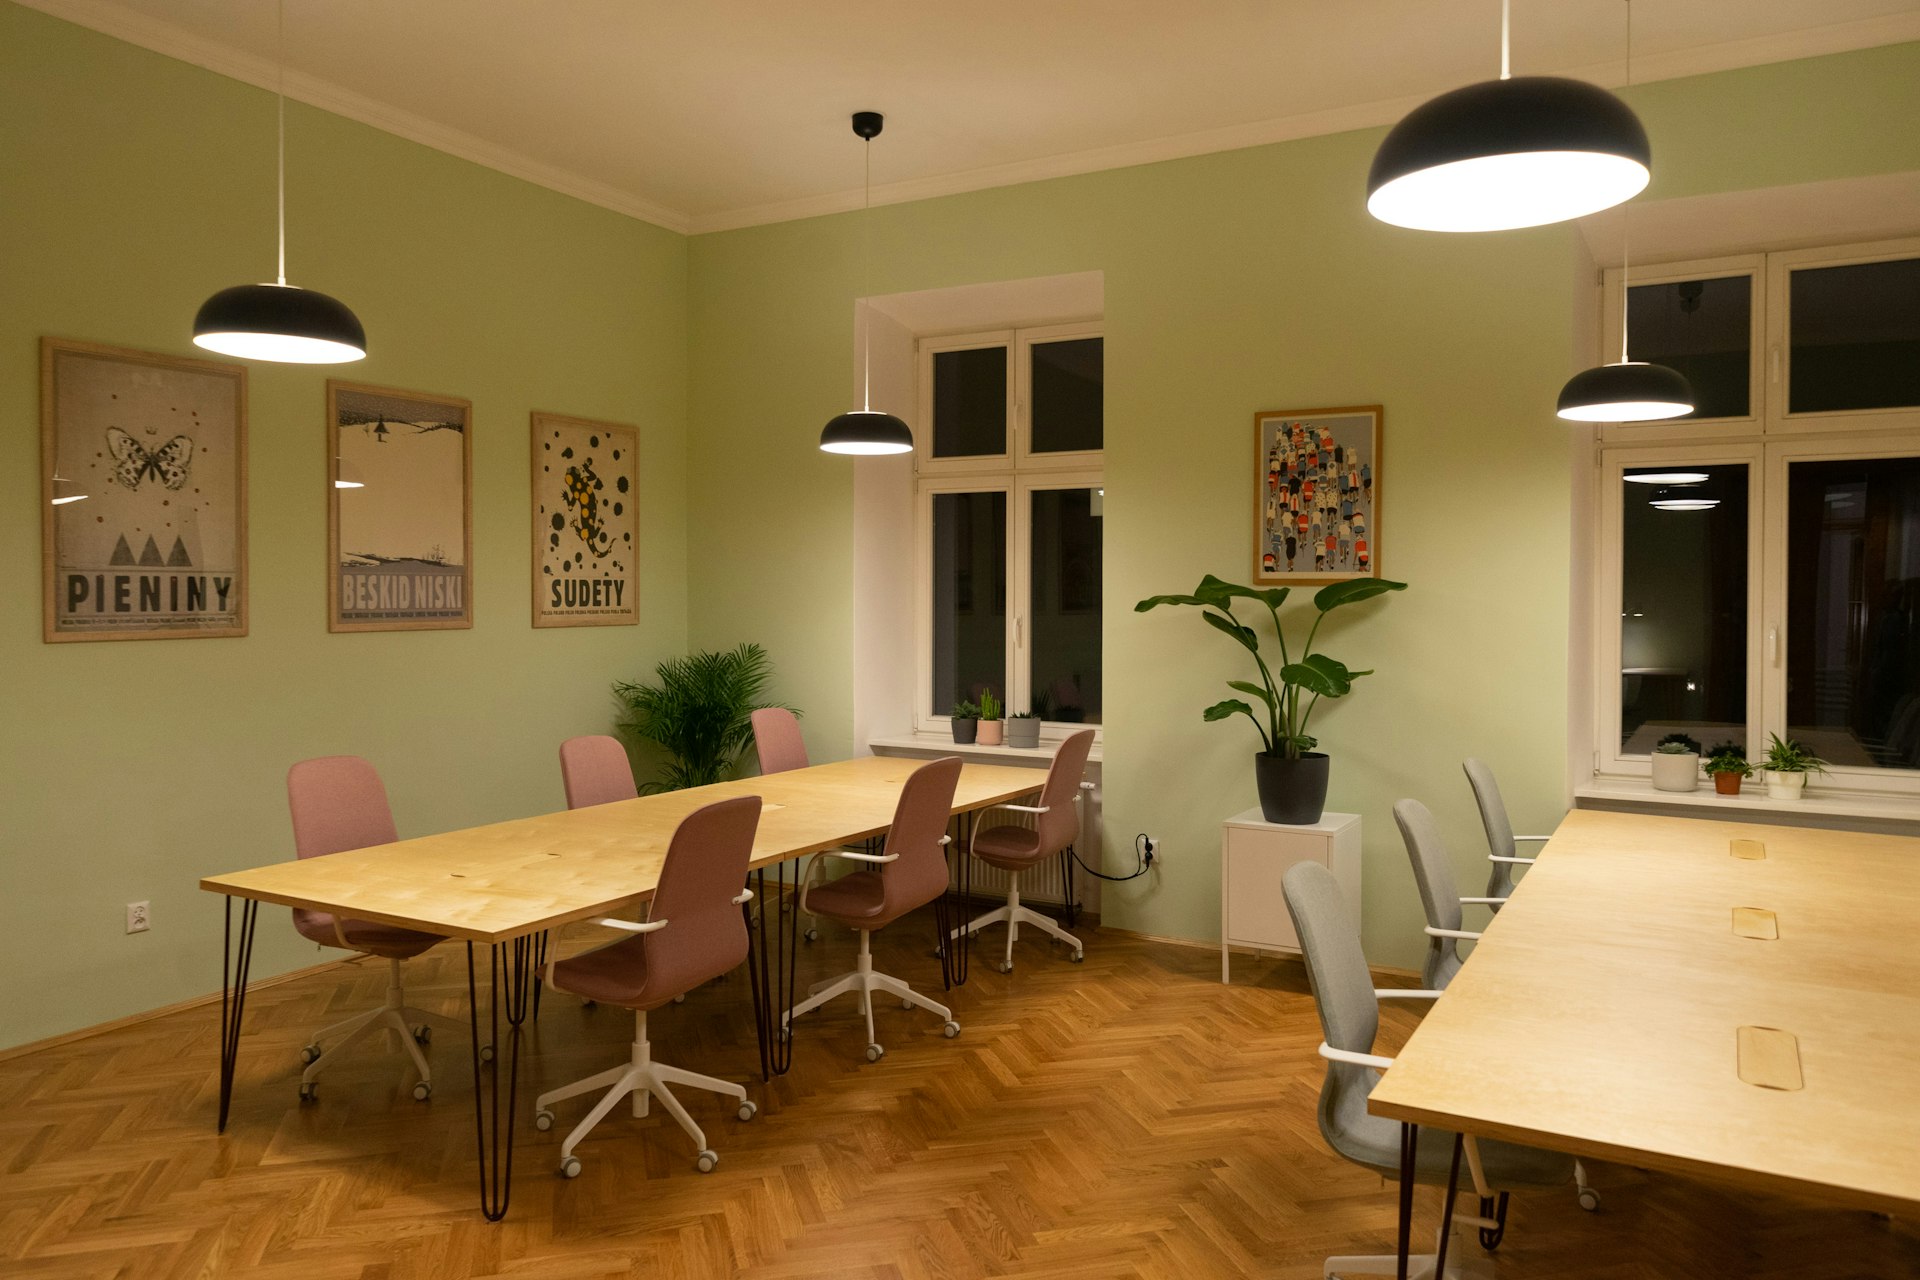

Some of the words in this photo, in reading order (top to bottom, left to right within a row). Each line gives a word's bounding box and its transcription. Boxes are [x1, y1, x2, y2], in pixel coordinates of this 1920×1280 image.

[67, 574, 232, 613] PIENINY
[342, 574, 411, 610] BESKID
[414, 575, 462, 609] NISKI
[551, 578, 625, 608] SUDETY
